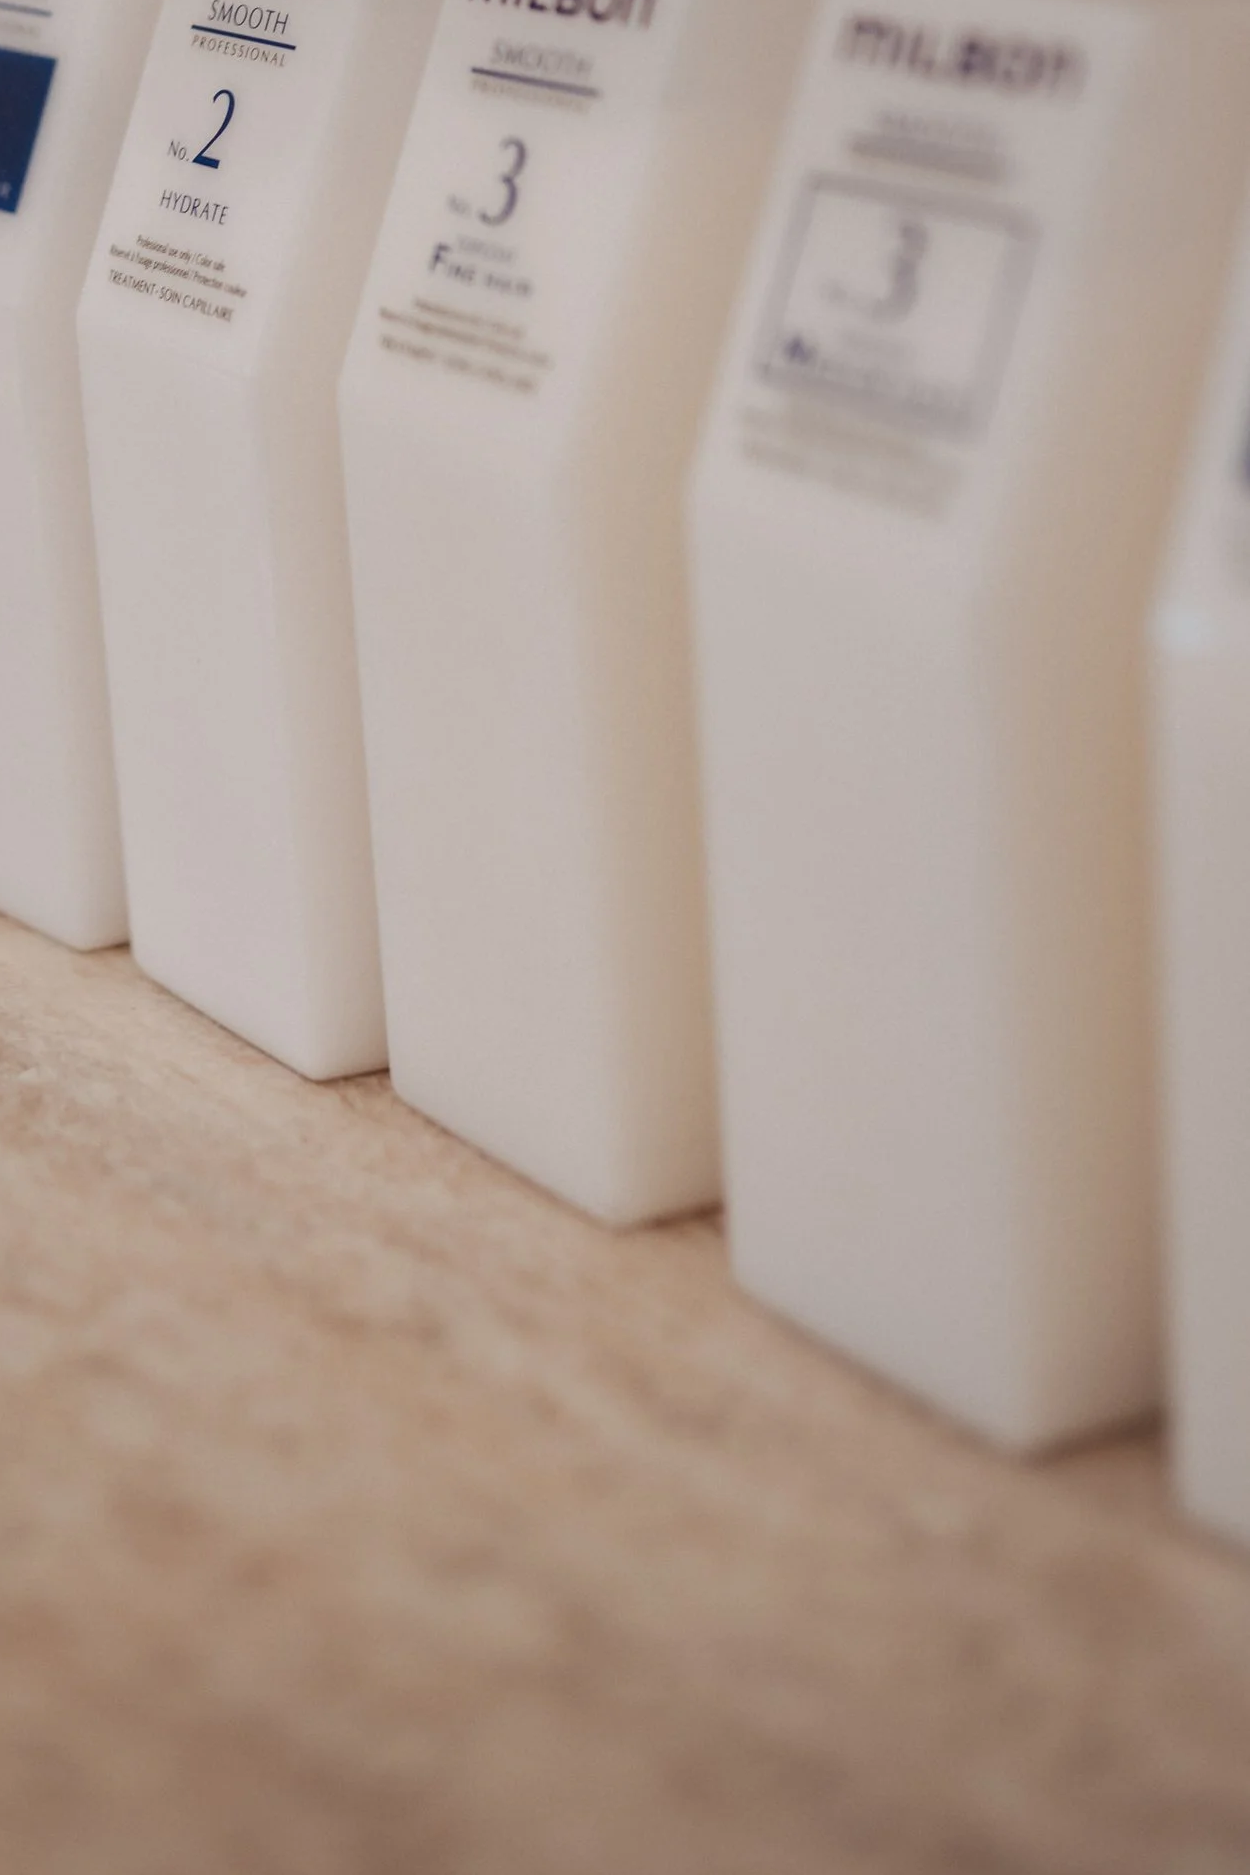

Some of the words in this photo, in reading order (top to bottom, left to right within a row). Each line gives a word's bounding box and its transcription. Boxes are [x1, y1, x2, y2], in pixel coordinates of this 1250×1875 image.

[190, 34, 286, 68] PROFESSIONAL
[191, 89, 236, 169] 2
[480, 135, 528, 225] 3
[159, 189, 230, 225] HYDRATE
[158, 286, 182, 305] SOIN
[182, 294, 235, 322] CAPILLAIRE
